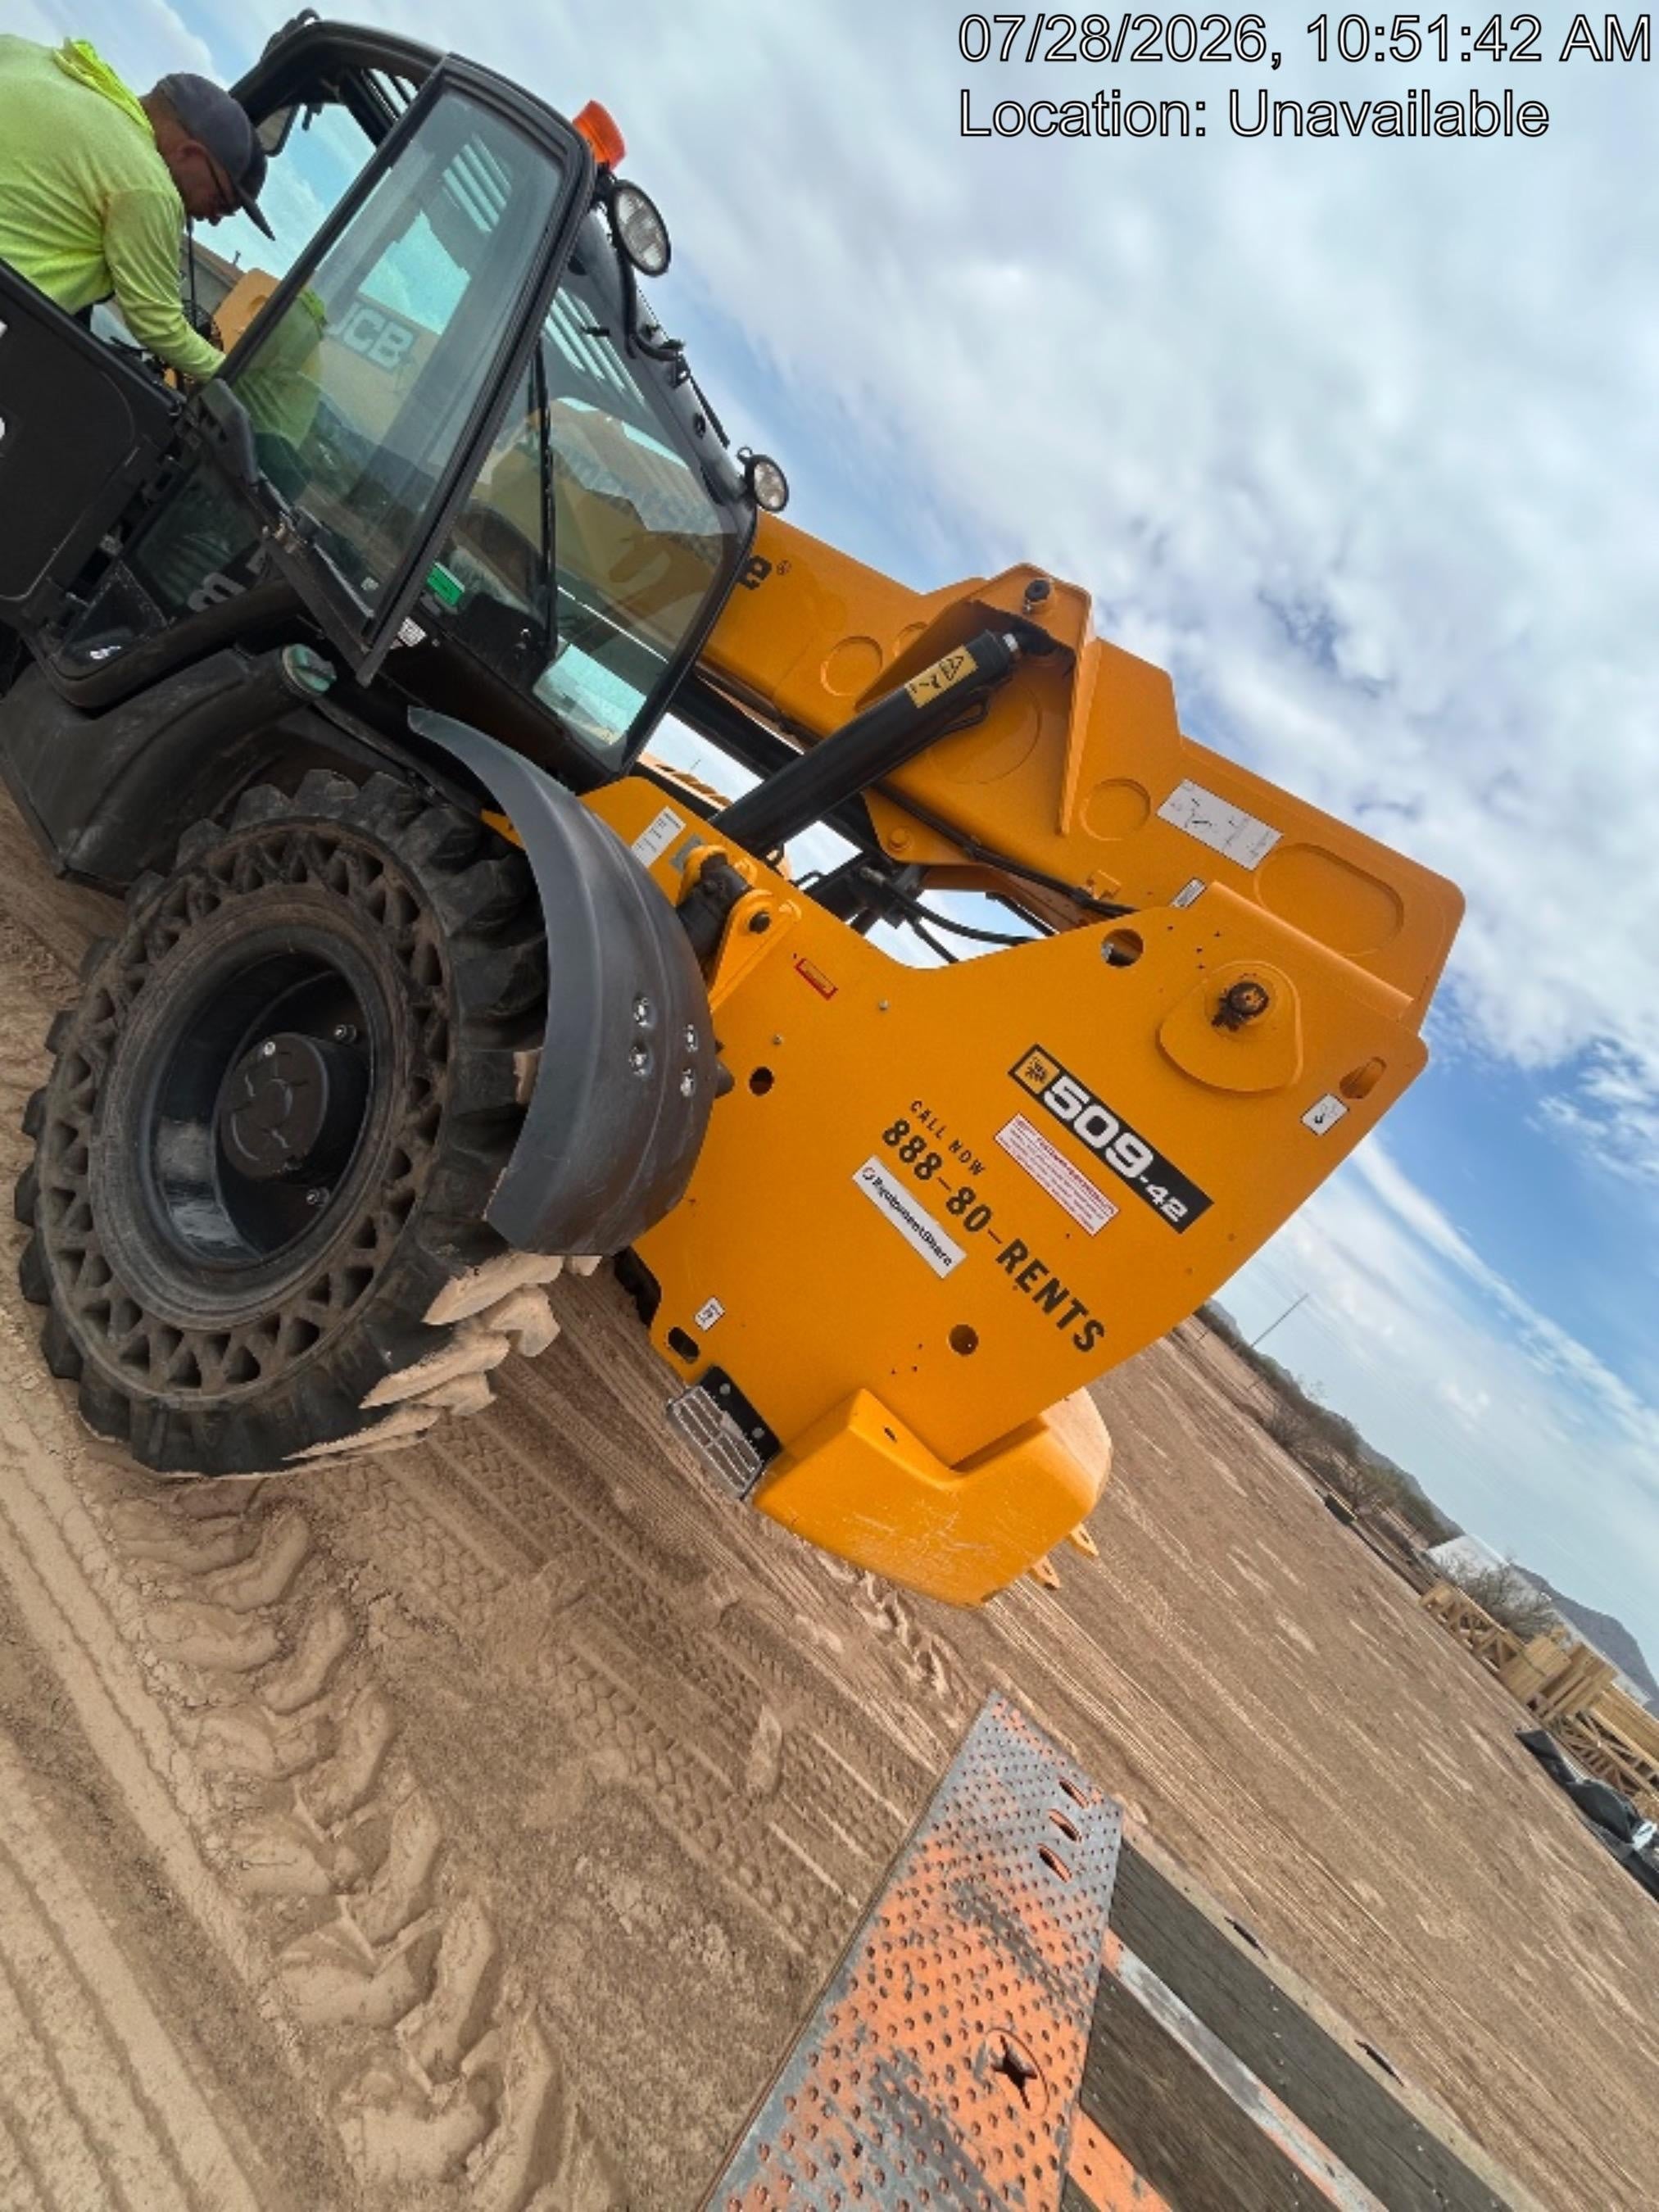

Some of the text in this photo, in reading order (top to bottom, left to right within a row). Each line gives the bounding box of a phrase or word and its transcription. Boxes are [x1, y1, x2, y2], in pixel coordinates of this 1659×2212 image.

[326, 301, 414, 369] JCB
[910, 1100, 985, 1176] CALL NOW
[1043, 1075, 1188, 1222] 509-42
[882, 1119, 1104, 1352] 888-80-RENTS
